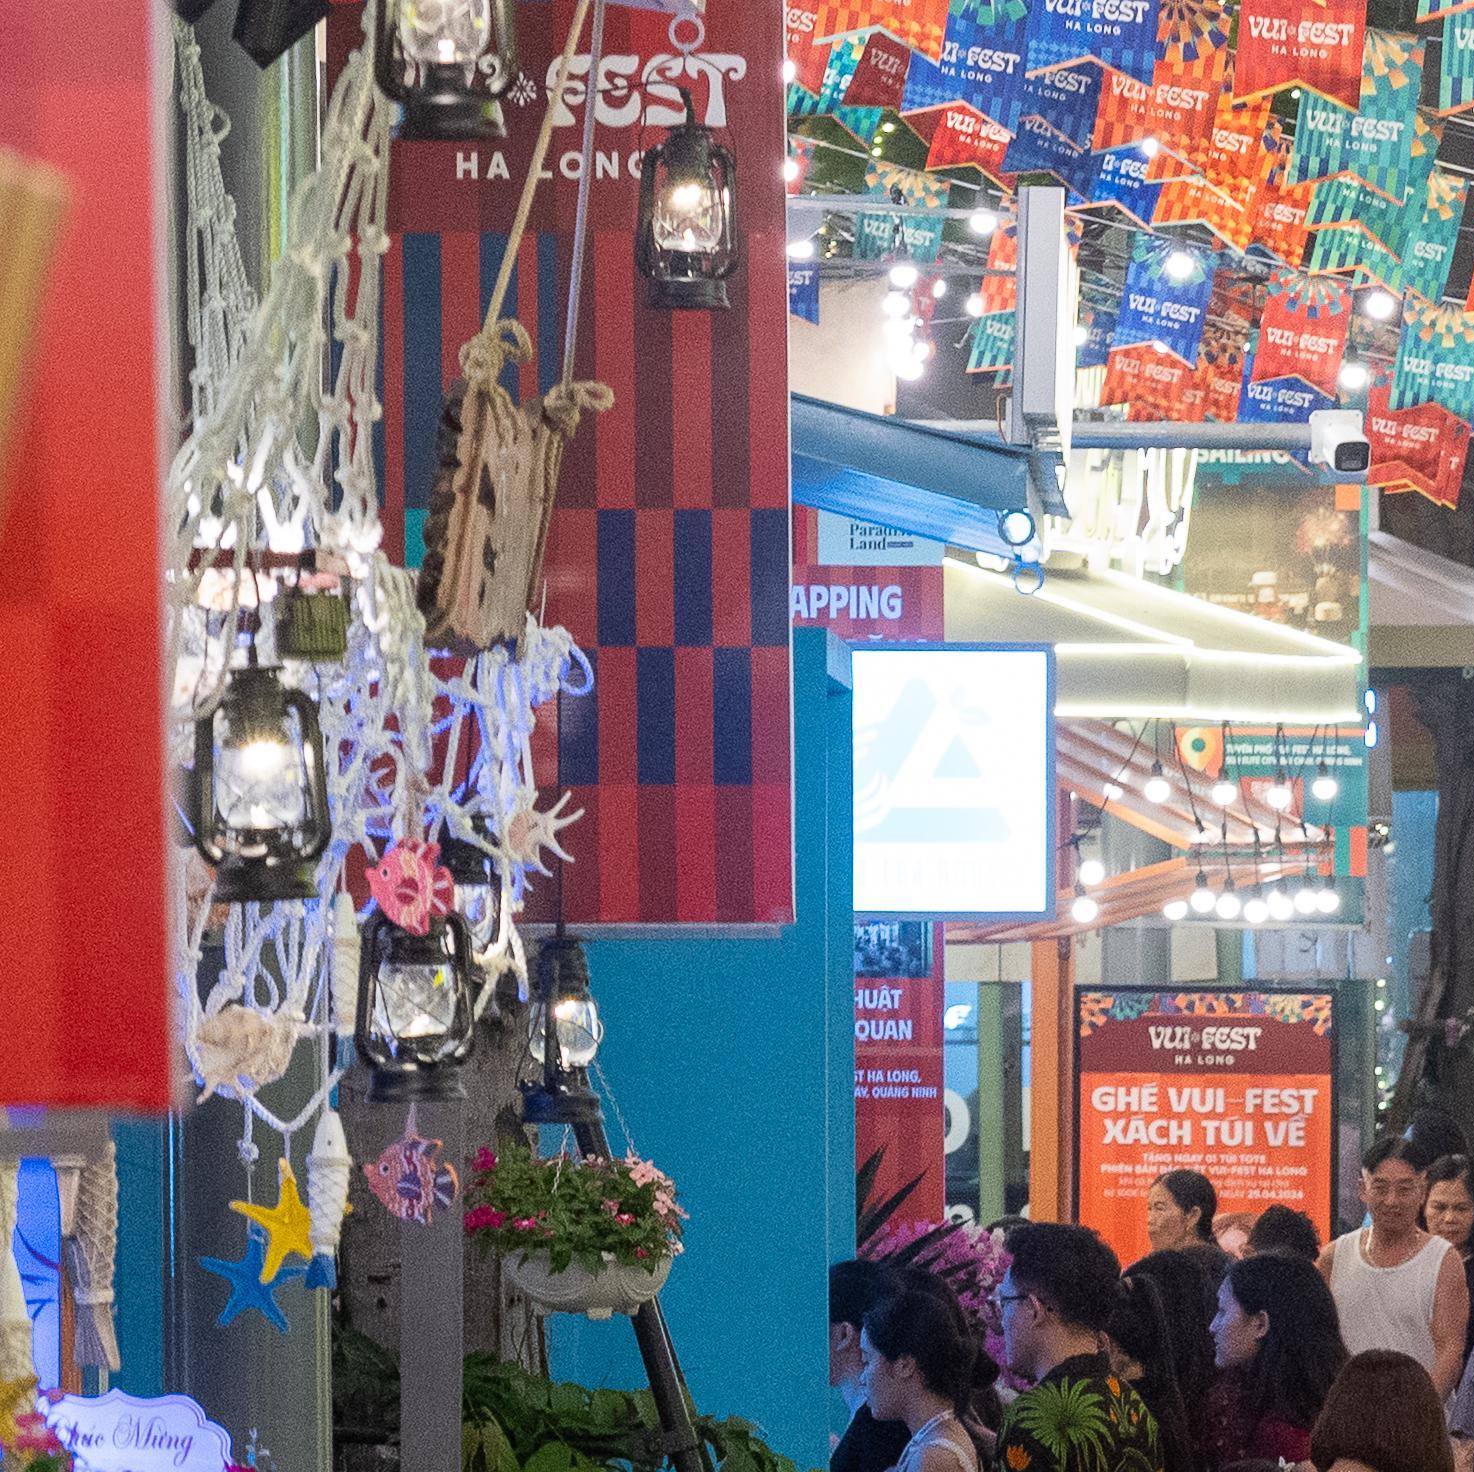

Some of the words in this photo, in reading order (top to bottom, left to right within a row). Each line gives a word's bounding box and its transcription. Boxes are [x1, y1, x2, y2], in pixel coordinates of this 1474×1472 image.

[1249, 16, 1287, 40] VUI
[1298, 21, 1354, 45] FEST
[1272, 45, 1286, 54] HA
[1293, 47, 1328, 59] LONG
[546, 53, 747, 127] FEST
[1112, 73, 1151, 100] VUI
[1156, 84, 1209, 110] FEST
[1131, 104, 1145, 113] HA
[1151, 109, 1181, 120] LONG
[1307, 109, 1344, 134] VUI
[1351, 116, 1404, 141] FEST
[1325, 138, 1340, 148] HA
[1346, 141, 1377, 153] LONG
[456, 151, 511, 180] HA
[850, 538, 887, 551] Land
[855, 1020, 912, 1042] QUAN
[1148, 1026, 1192, 1049] VUI
[1201, 1026, 1262, 1050] FEST
[1174, 1055, 1192, 1065] HA
[1198, 1054, 1235, 1066] LONG
